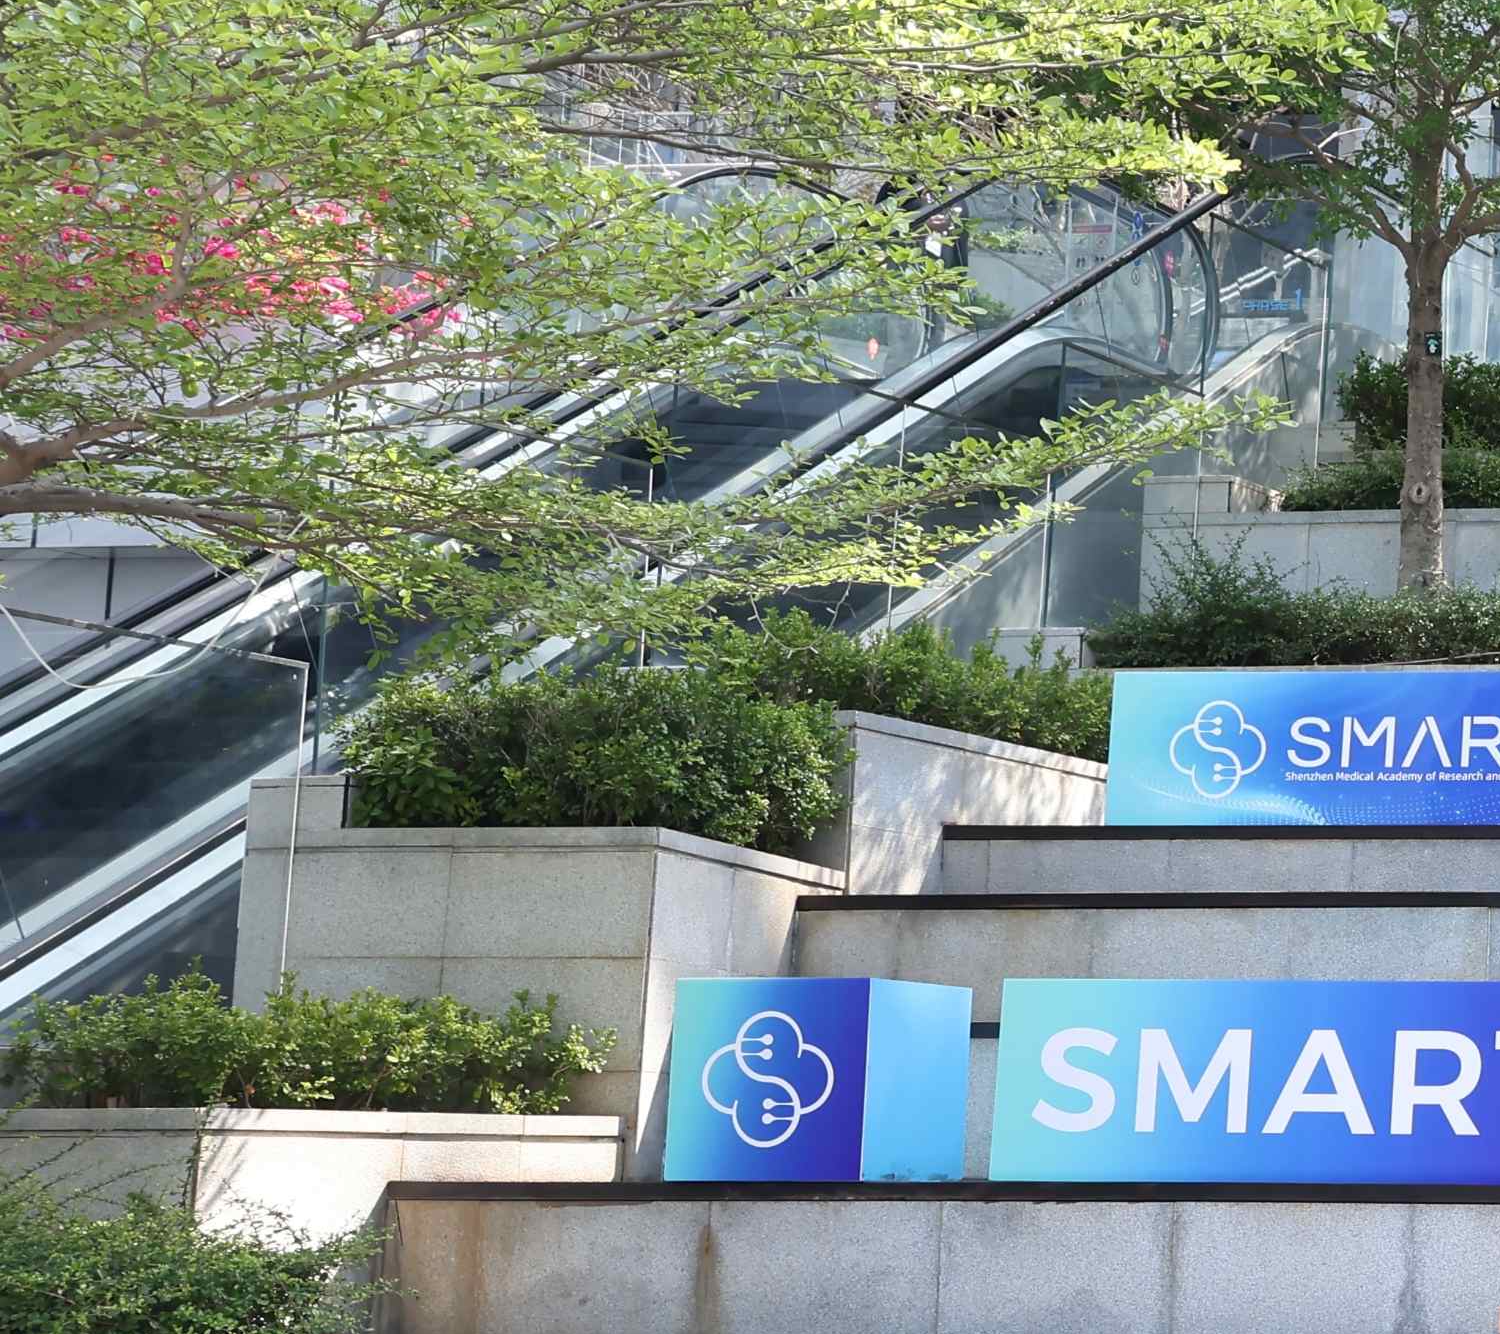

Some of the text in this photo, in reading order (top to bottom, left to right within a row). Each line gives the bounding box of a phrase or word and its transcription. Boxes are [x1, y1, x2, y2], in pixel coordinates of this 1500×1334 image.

[1285, 771, 1333, 781] Shenzhen
[1336, 771, 1374, 781] Medical
[1377, 771, 1423, 783] Academy
[1425, 771, 1437, 781] of
[1439, 771, 1484, 781] Research
